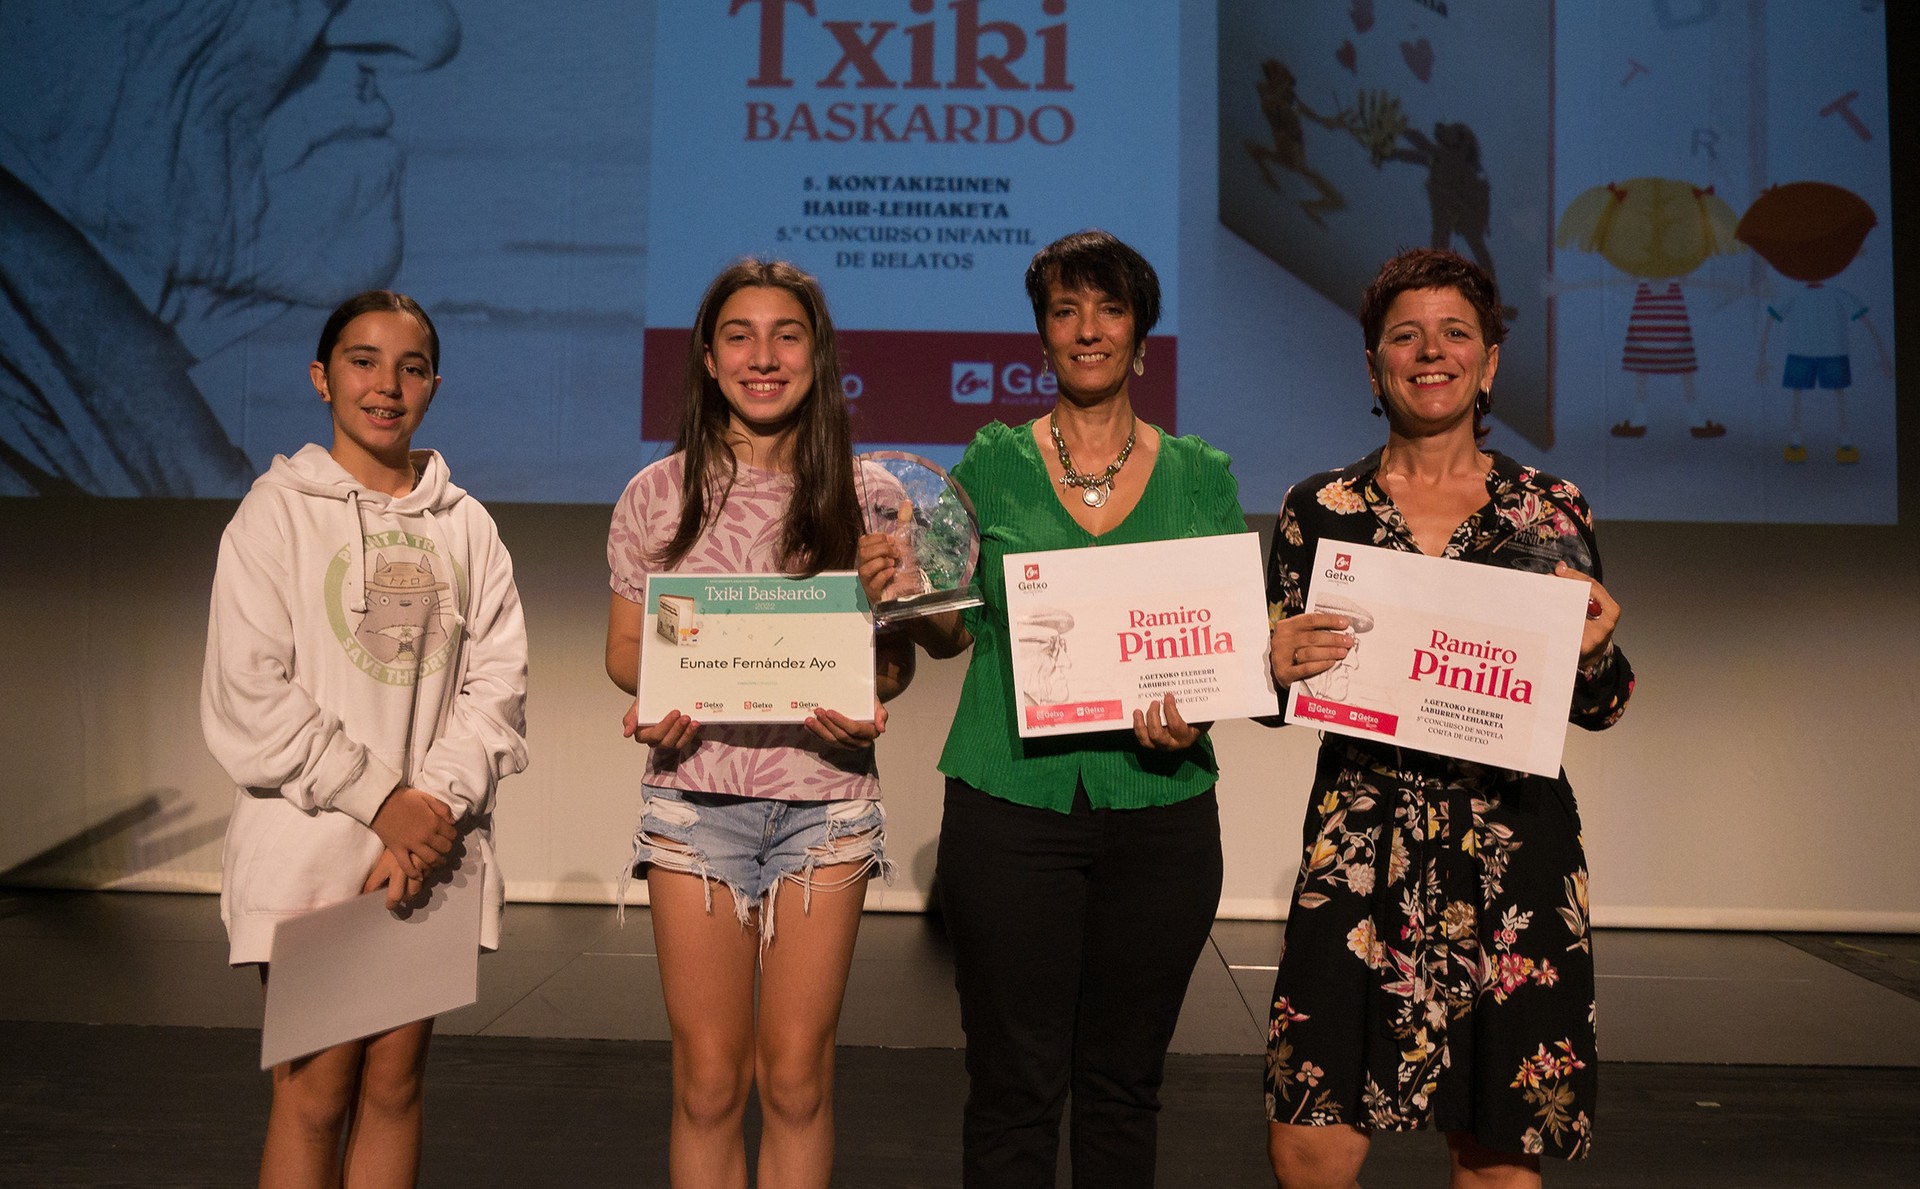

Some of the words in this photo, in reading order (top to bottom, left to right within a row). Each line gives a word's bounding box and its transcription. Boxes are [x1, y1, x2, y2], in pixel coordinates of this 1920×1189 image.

[728, 0, 1076, 92] Txiki
[743, 102, 1076, 146] BASKARDO
[827, 175, 1011, 193] KONTAKIZUNEN
[803, 200, 1009, 219] HAUR-LEHIAKETA
[805, 226, 931, 242] CONCURSO
[937, 227, 1035, 245] INFANTIL
[836, 252, 865, 268] DE
[871, 252, 974, 270] RELATOS
[397, 531, 409, 546] A
[1325, 569, 1355, 582] Getxo
[705, 586, 743, 601] Txiki
[748, 586, 827, 601] Baskardo
[1018, 581, 1048, 591] Getxo
[755, 602, 776, 611] 2022
[1128, 606, 1211, 629] Ramiro
[1117, 625, 1235, 663] Pinilla
[1429, 629, 1518, 665] Ramiro
[342, 636, 380, 678] SAVE
[680, 657, 729, 669] Eunate
[733, 656, 806, 669] Fernández
[809, 657, 836, 672] Ayo
[1138, 680, 1176, 689] LABURREN
[1408, 649, 1534, 705] Pinilla
[752, 701, 773, 709] Getxo
[1316, 705, 1337, 716] Getxo
[1467, 706, 1503, 720] ELEBERRI
[1358, 713, 1379, 724] Getxo
[1420, 705, 1460, 719] LABURREN
[1462, 714, 1503, 729] LEHIAKETA
[1424, 718, 1464, 730] CONCURSO
[1465, 725, 1474, 733] DE
[1475, 728, 1503, 740] NOVELA
[1428, 727, 1452, 738] CORTA
[1464, 735, 1489, 746] GETXO
